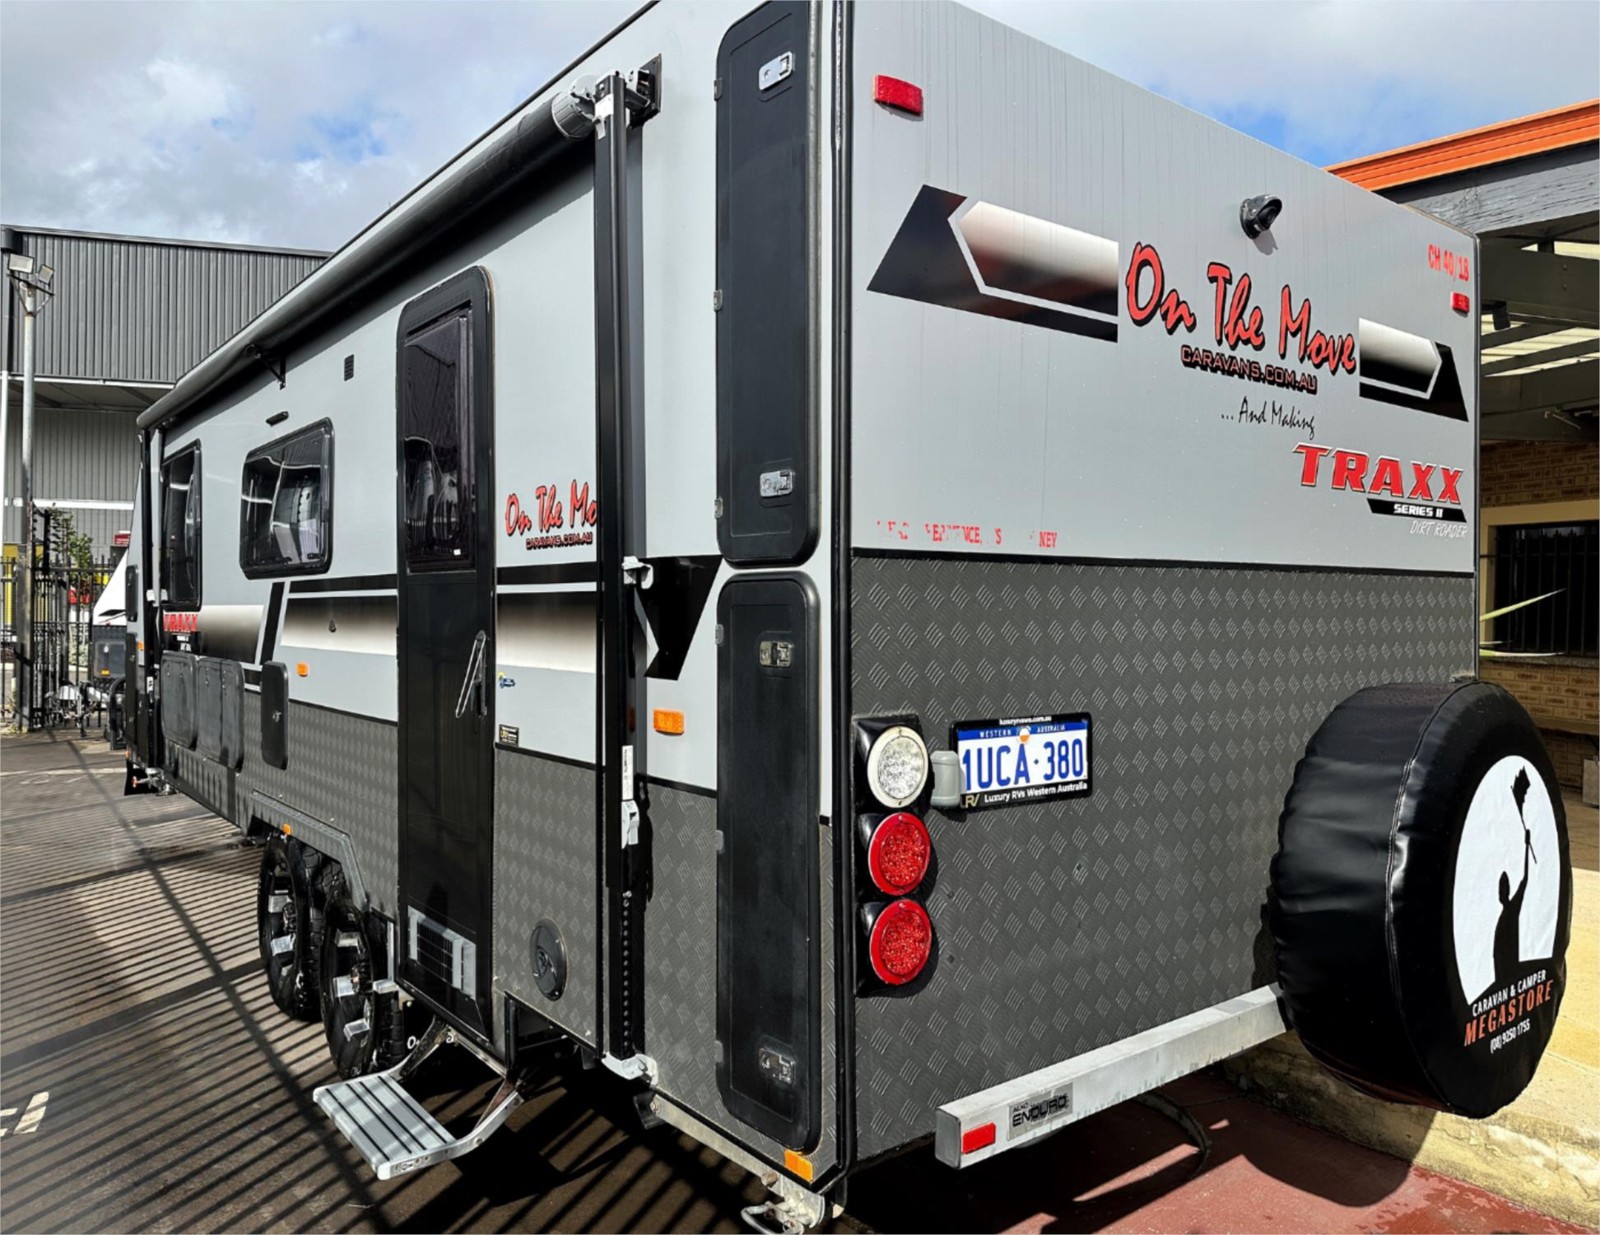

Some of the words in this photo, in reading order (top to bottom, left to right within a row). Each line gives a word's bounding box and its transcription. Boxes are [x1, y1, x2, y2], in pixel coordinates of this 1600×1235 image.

[1428, 244, 1441, 272] CH
[1125, 241, 1196, 335] On
[1207, 262, 1265, 350] The
[1279, 284, 1357, 374] Move
[1180, 344, 1317, 395] CARAVANS.COM.AU
[1271, 401, 1315, 440] Making
[1292, 442, 1464, 505] TRAXX
[505, 493, 532, 537] On
[535, 484, 563, 533] The
[569, 479, 597, 529] Mo
[1393, 503, 1433, 517] SERIES
[1435, 508, 1444, 518] II
[1409, 520, 1435, 534] DIRT
[1433, 523, 1468, 538] ROADER
[980, 730, 1011, 738] WESTERN
[1037, 724, 1066, 733] AUSTRALIA
[984, 792, 1010, 803] Luxury
[1012, 789, 1026, 799] RVs
[1027, 784, 1056, 797] Western
[1057, 781, 1088, 793] Australia
[1472, 988, 1508, 1016] CARAVAN
[1510, 984, 1516, 997] &
[1517, 969, 1547, 993] CAMPER
[1464, 979, 1553, 1047] MEGASTORE
[1012, 1094, 1069, 1128] ENDURO
